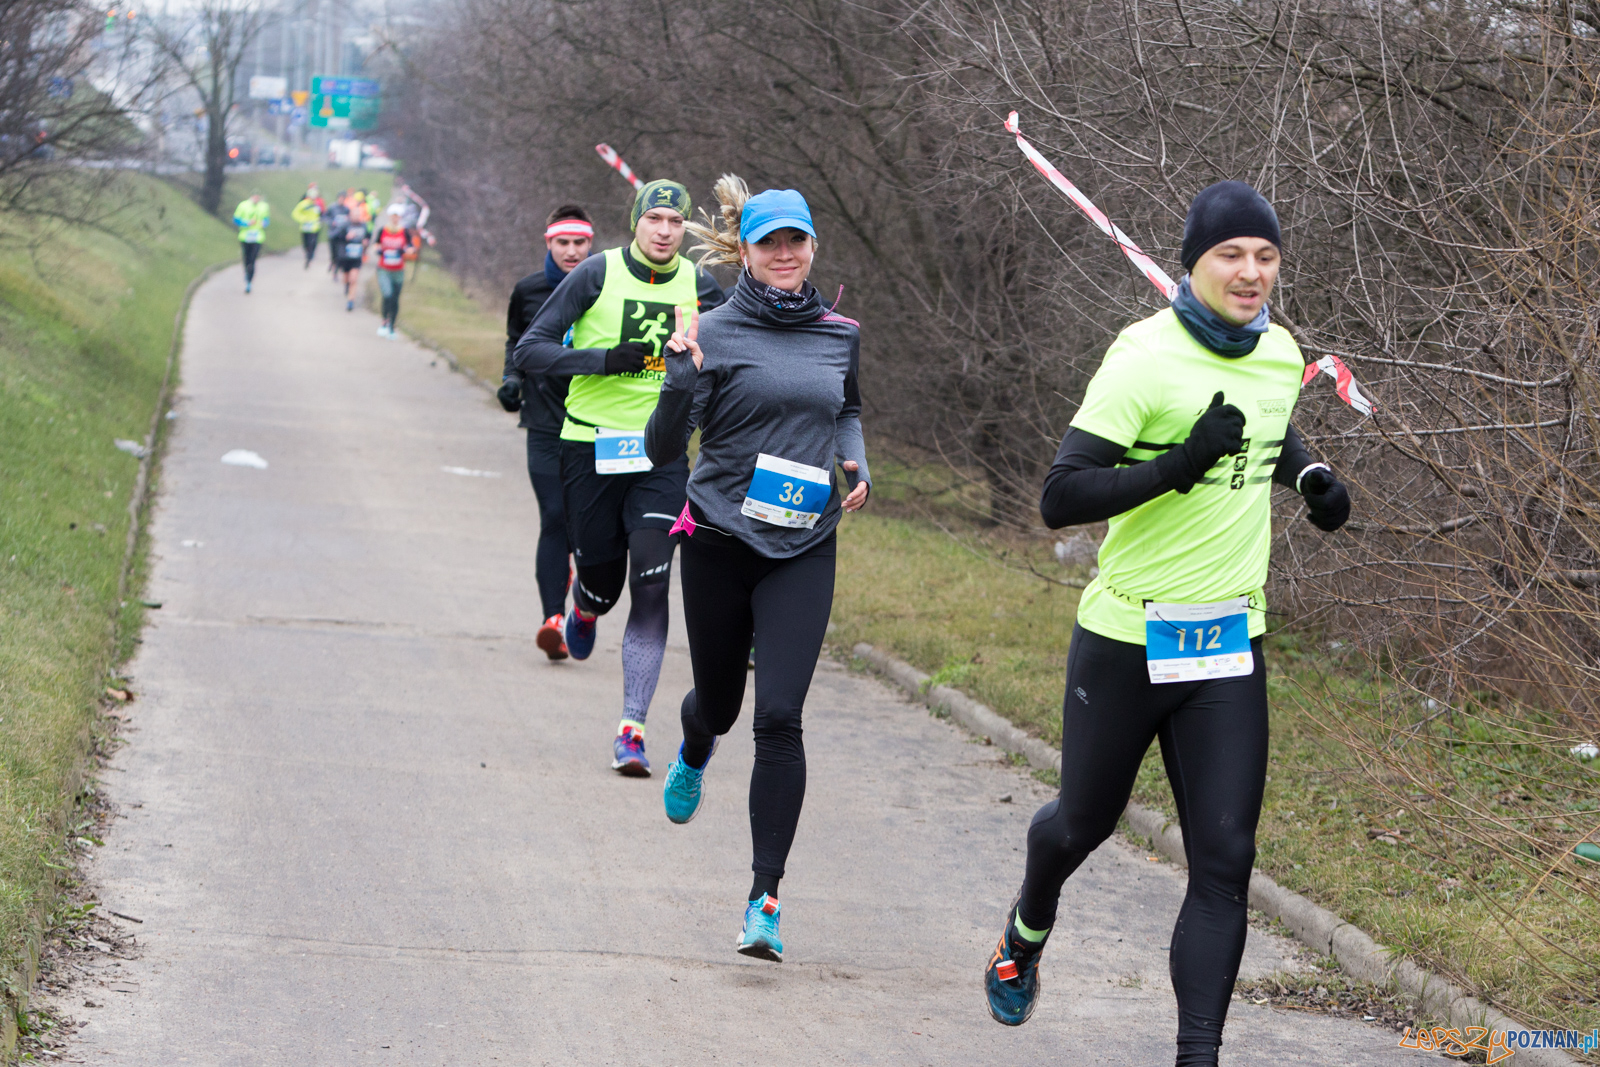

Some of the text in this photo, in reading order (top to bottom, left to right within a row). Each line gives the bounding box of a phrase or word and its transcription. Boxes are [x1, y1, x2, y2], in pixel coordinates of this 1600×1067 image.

[618, 439, 640, 456] 22
[778, 482, 804, 505] 36
[1176, 625, 1222, 652] 112
